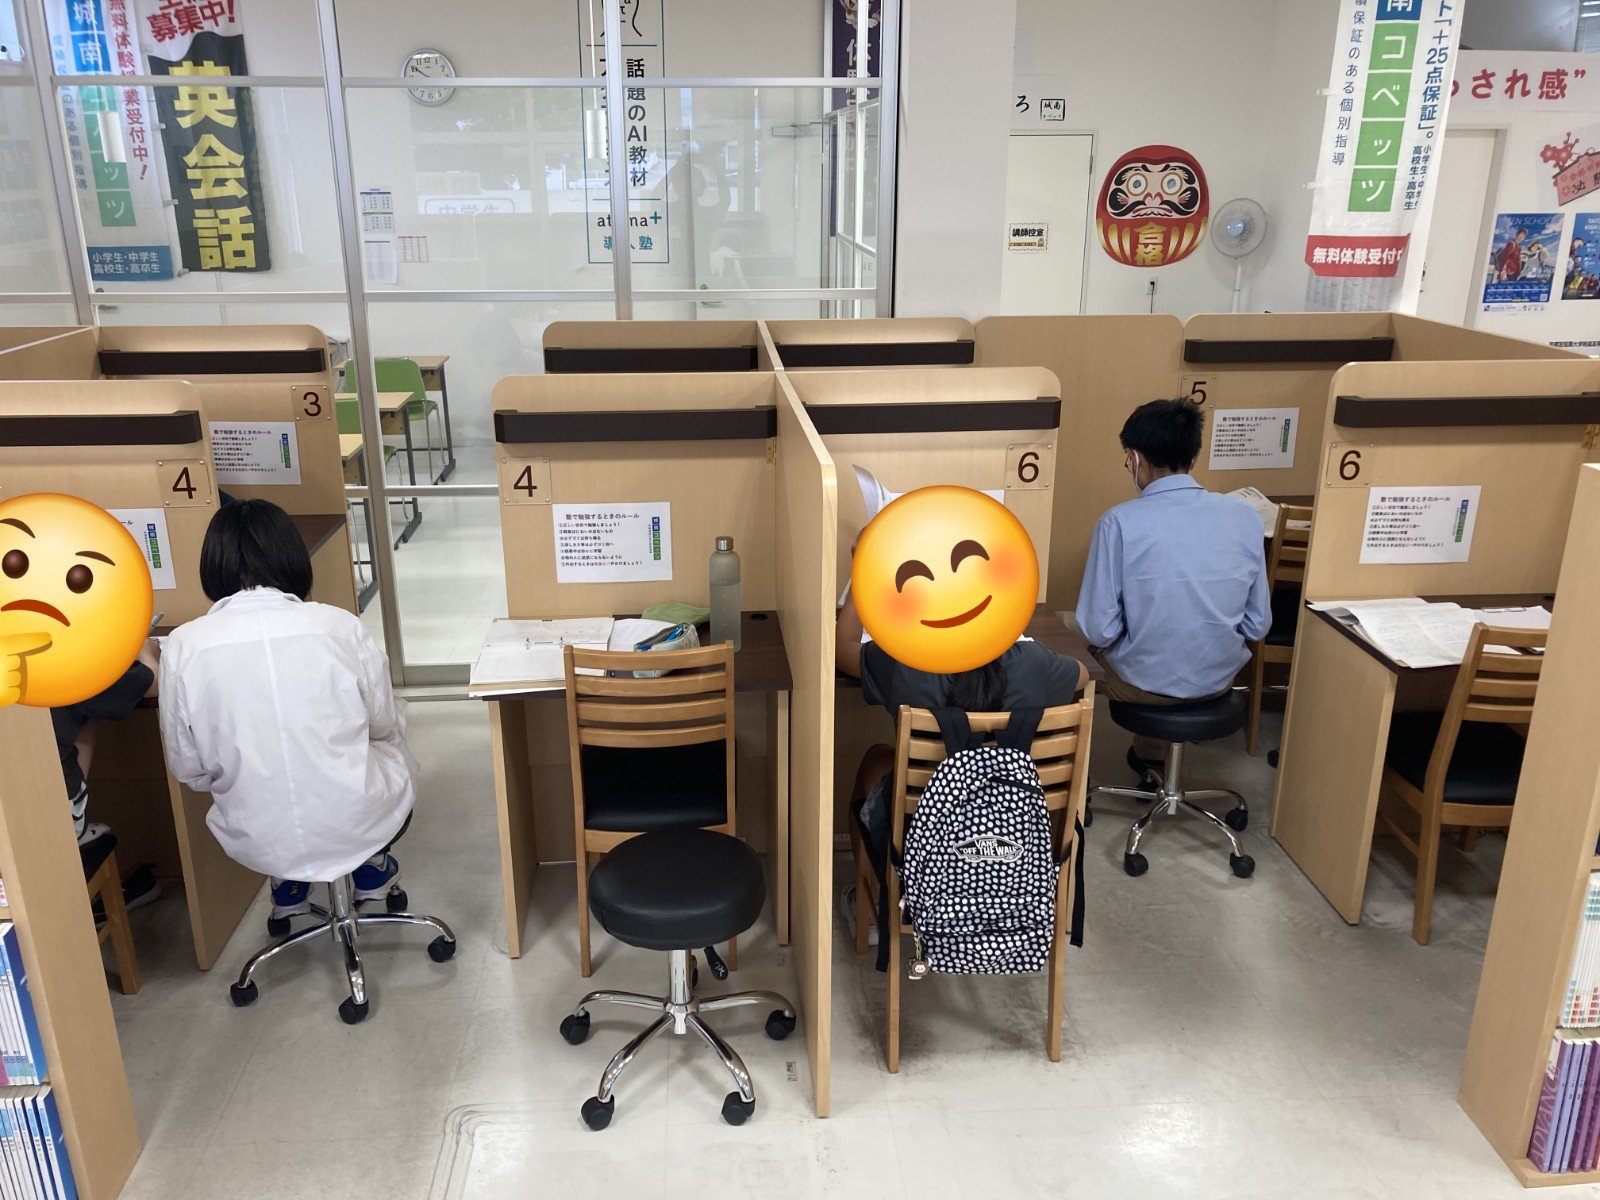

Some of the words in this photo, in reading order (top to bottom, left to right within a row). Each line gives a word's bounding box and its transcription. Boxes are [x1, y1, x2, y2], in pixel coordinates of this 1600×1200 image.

[626, 58, 648, 187] 話題のAI教材
[168, 60, 256, 270] 英会話
[597, 211, 662, 227] atma+
[603, 236, 653, 250] 導塾
[1134, 221, 1167, 265] 合格
[303, 391, 322, 417] 3
[1191, 381, 1207, 405] 5
[513, 465, 537, 497] 4
[1017, 451, 1040, 483] 6
[1339, 450, 1361, 481] 6
[172, 467, 197, 499] 4
[974, 839, 998, 849] VANS
[979, 845, 996, 856] THE
